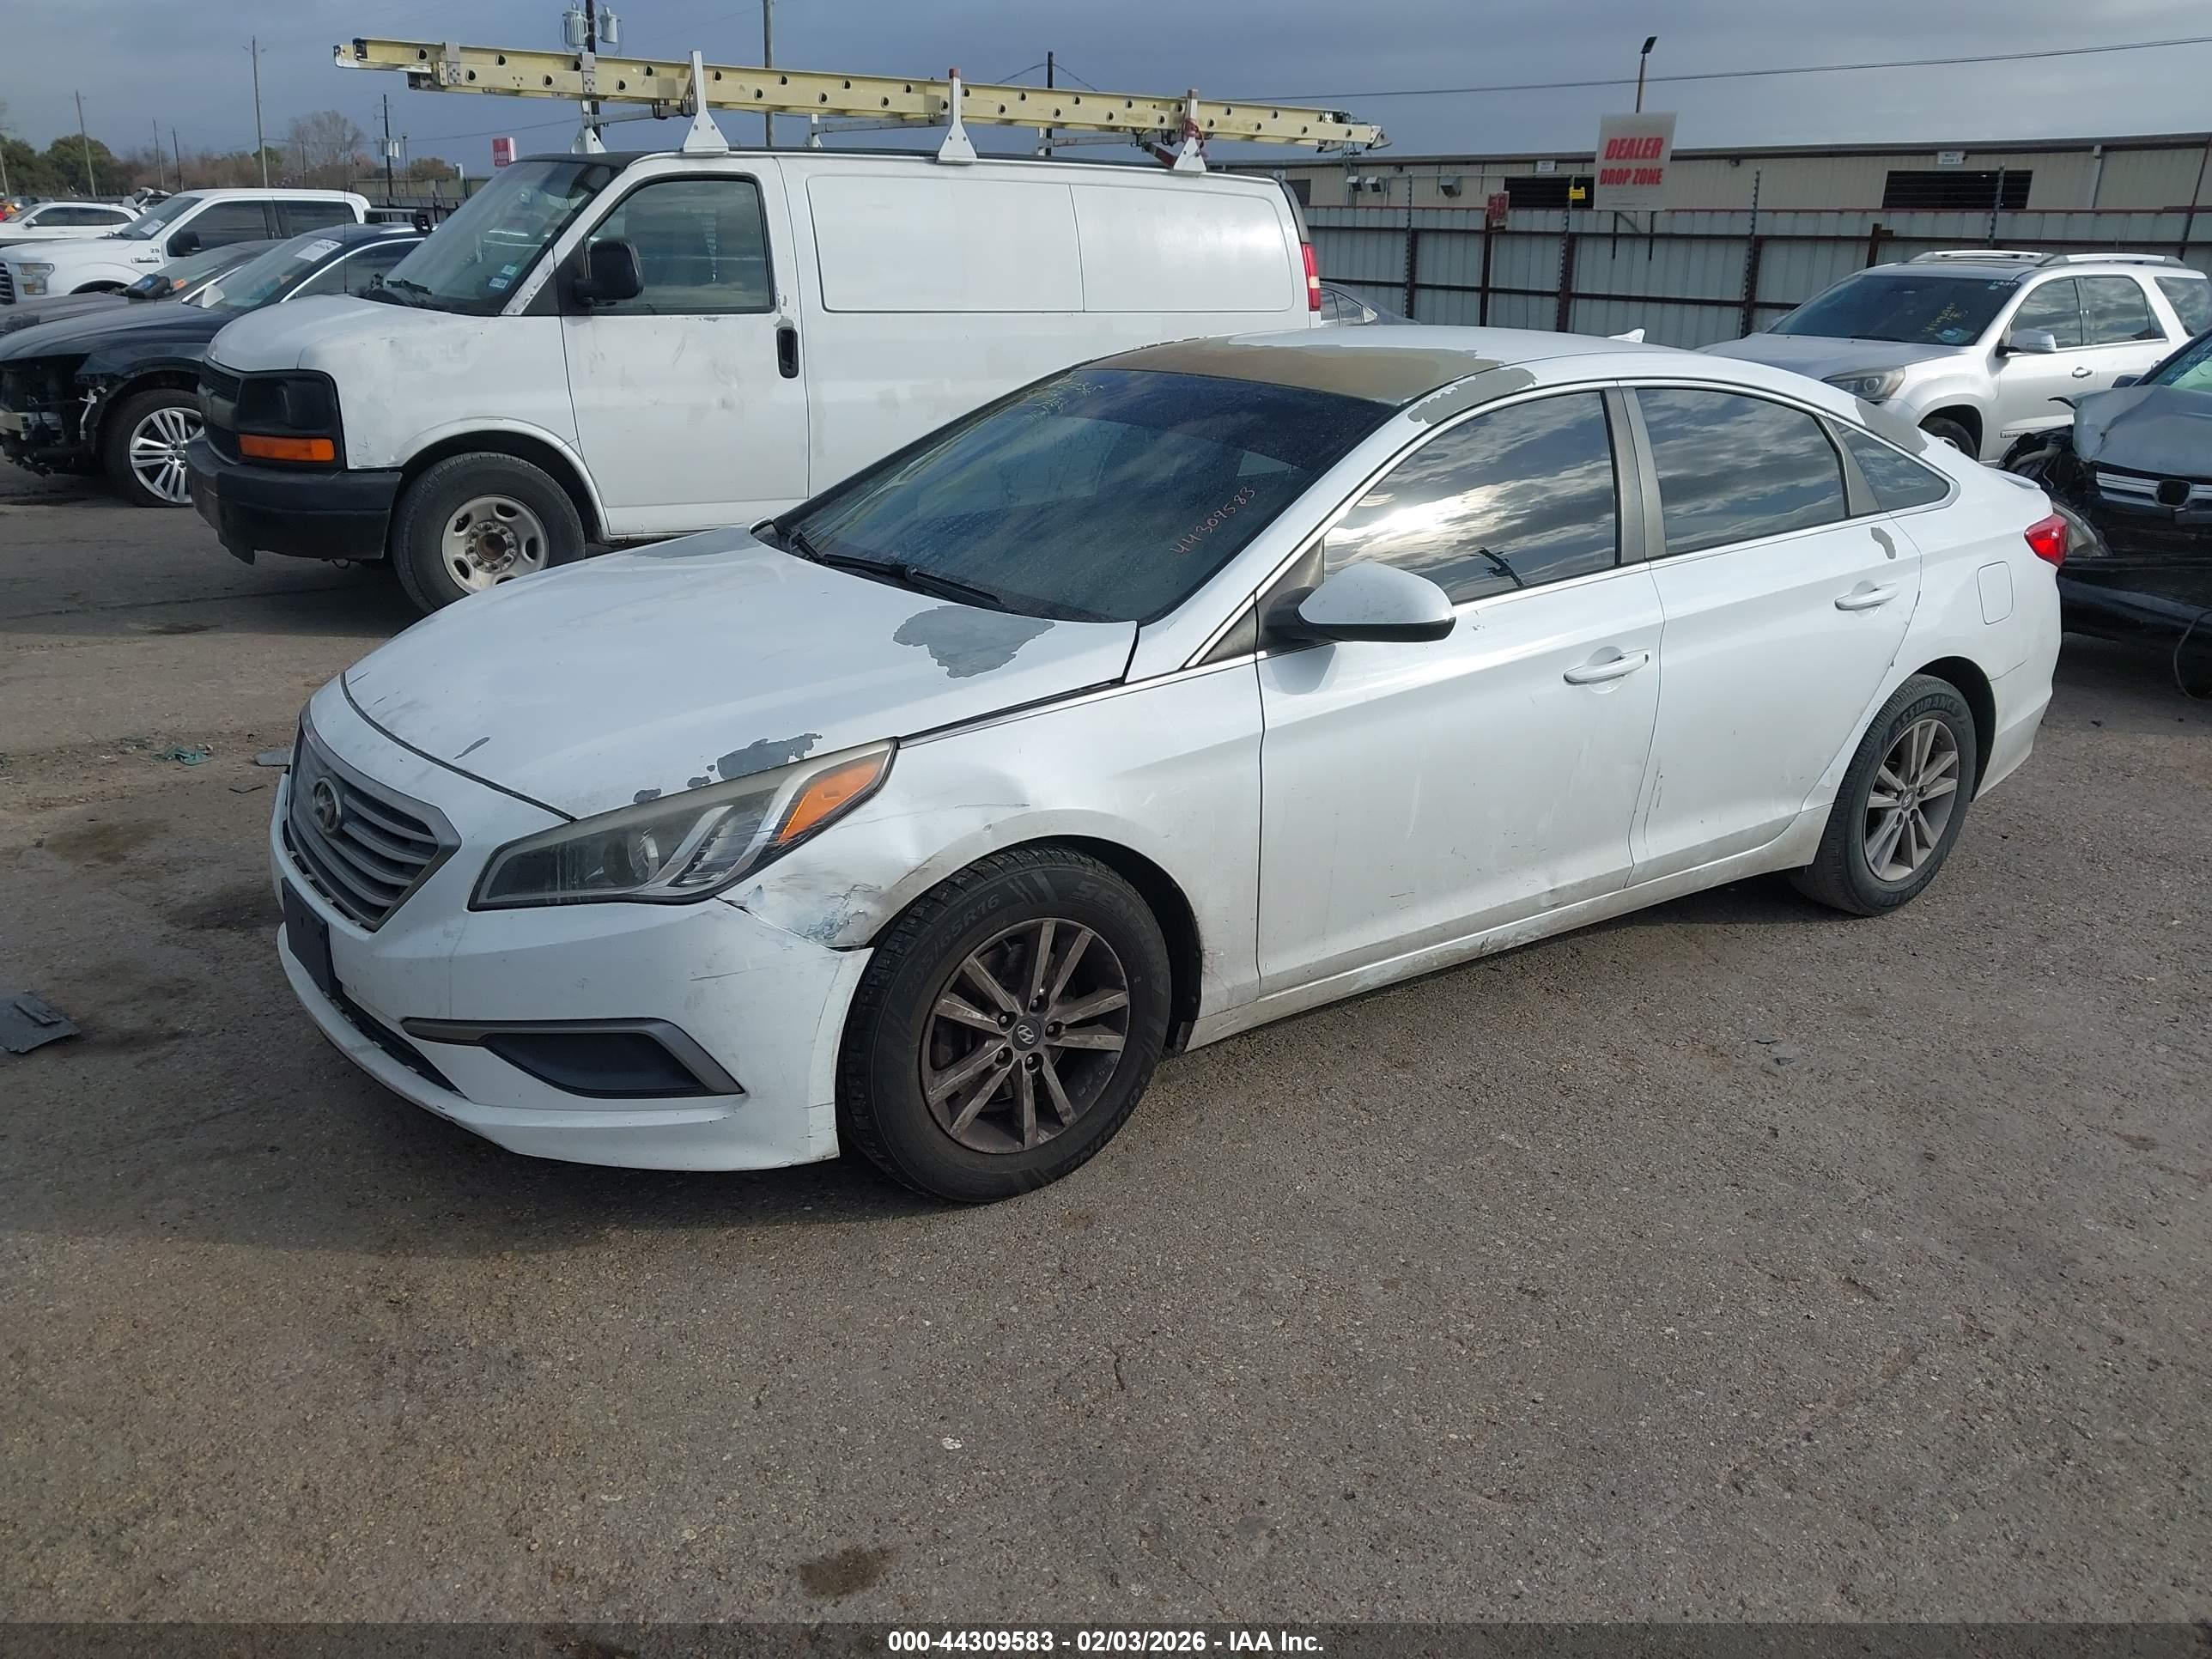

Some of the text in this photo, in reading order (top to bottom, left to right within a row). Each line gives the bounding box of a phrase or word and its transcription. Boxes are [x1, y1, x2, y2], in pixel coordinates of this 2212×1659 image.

[1604, 137, 1664, 161] DEALER
[1600, 167, 1663, 185] DROP ZONE
[1169, 487, 1255, 554] 44309583
